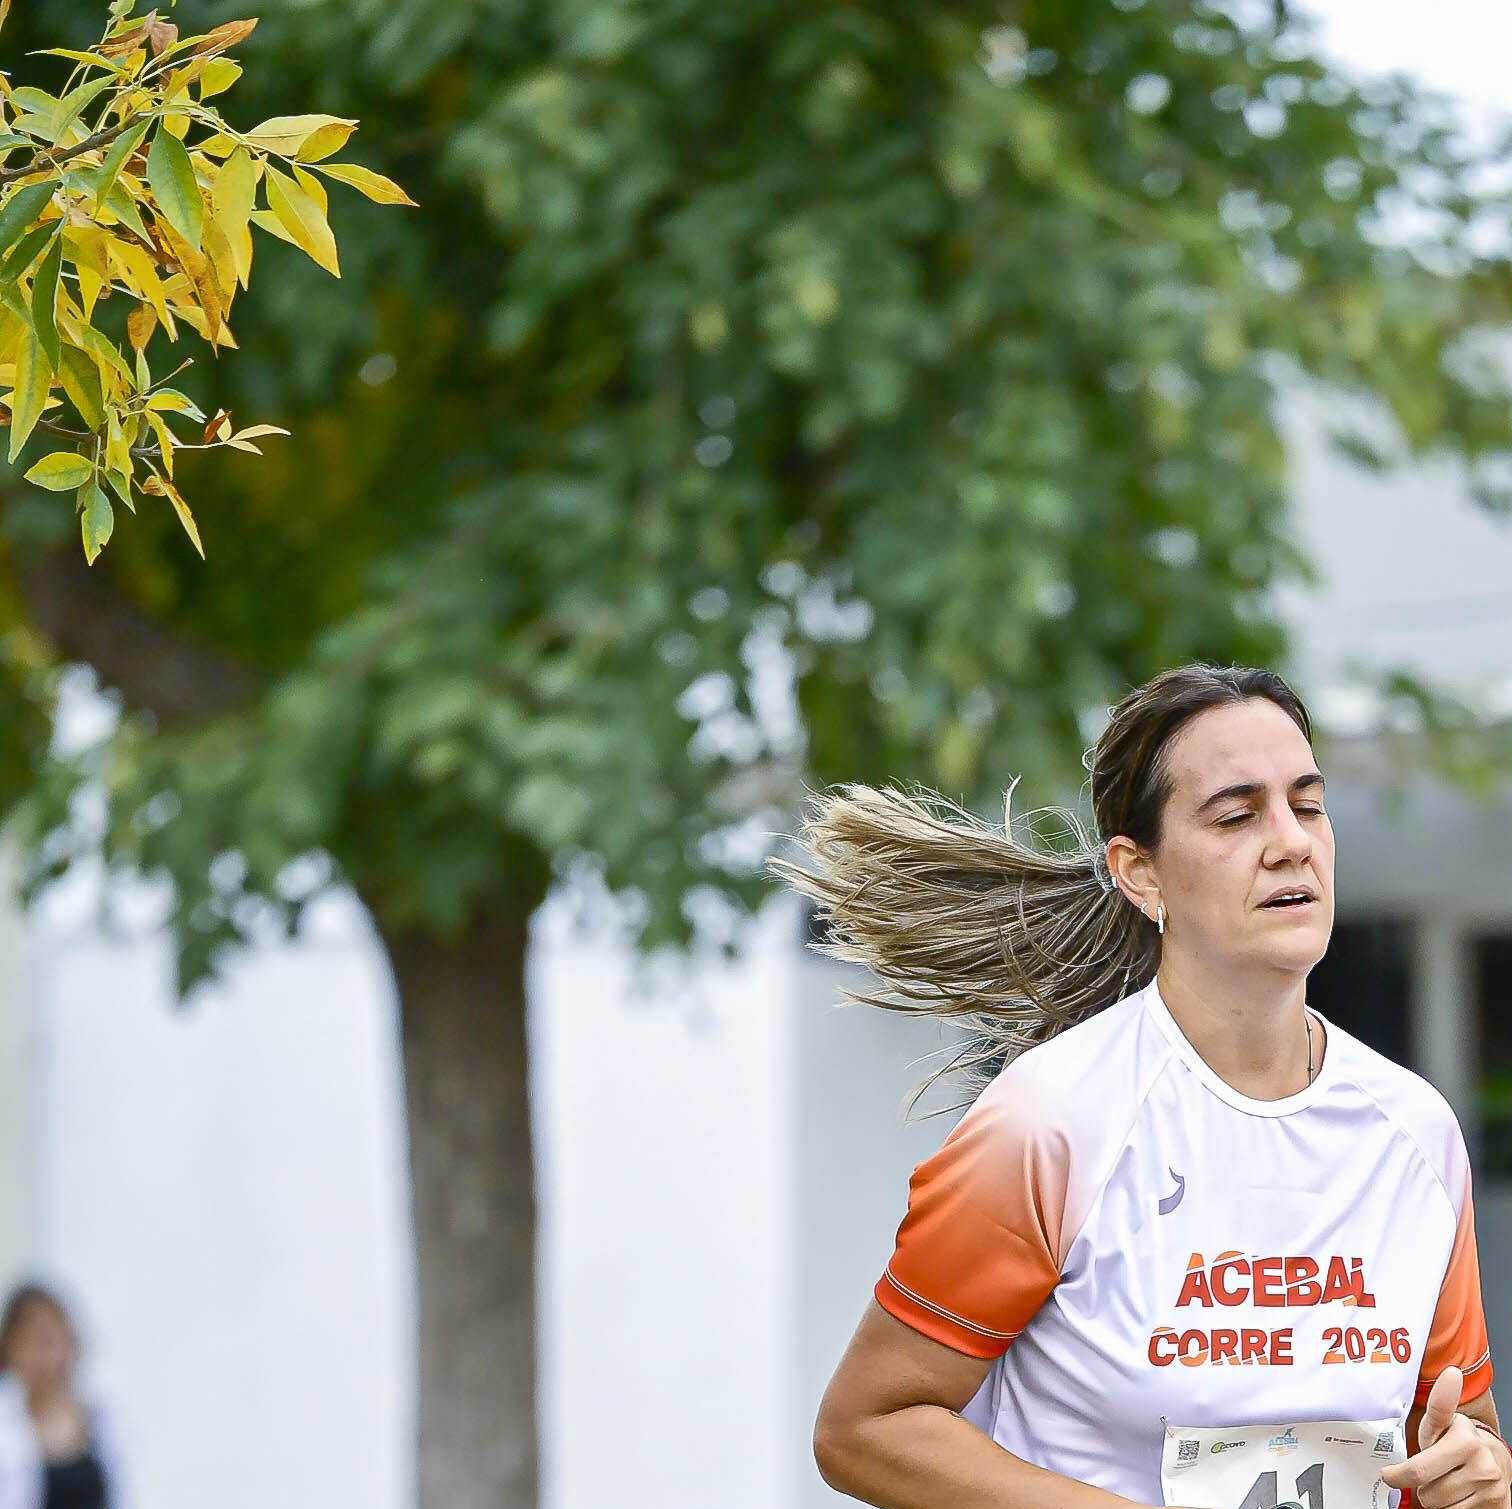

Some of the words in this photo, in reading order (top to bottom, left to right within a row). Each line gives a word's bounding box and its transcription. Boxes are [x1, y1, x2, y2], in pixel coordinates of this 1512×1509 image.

[1175, 1250, 1376, 1308] ACEBAL
[1148, 1326, 1294, 1367] CORRE
[1322, 1327, 1411, 1364] 2026
